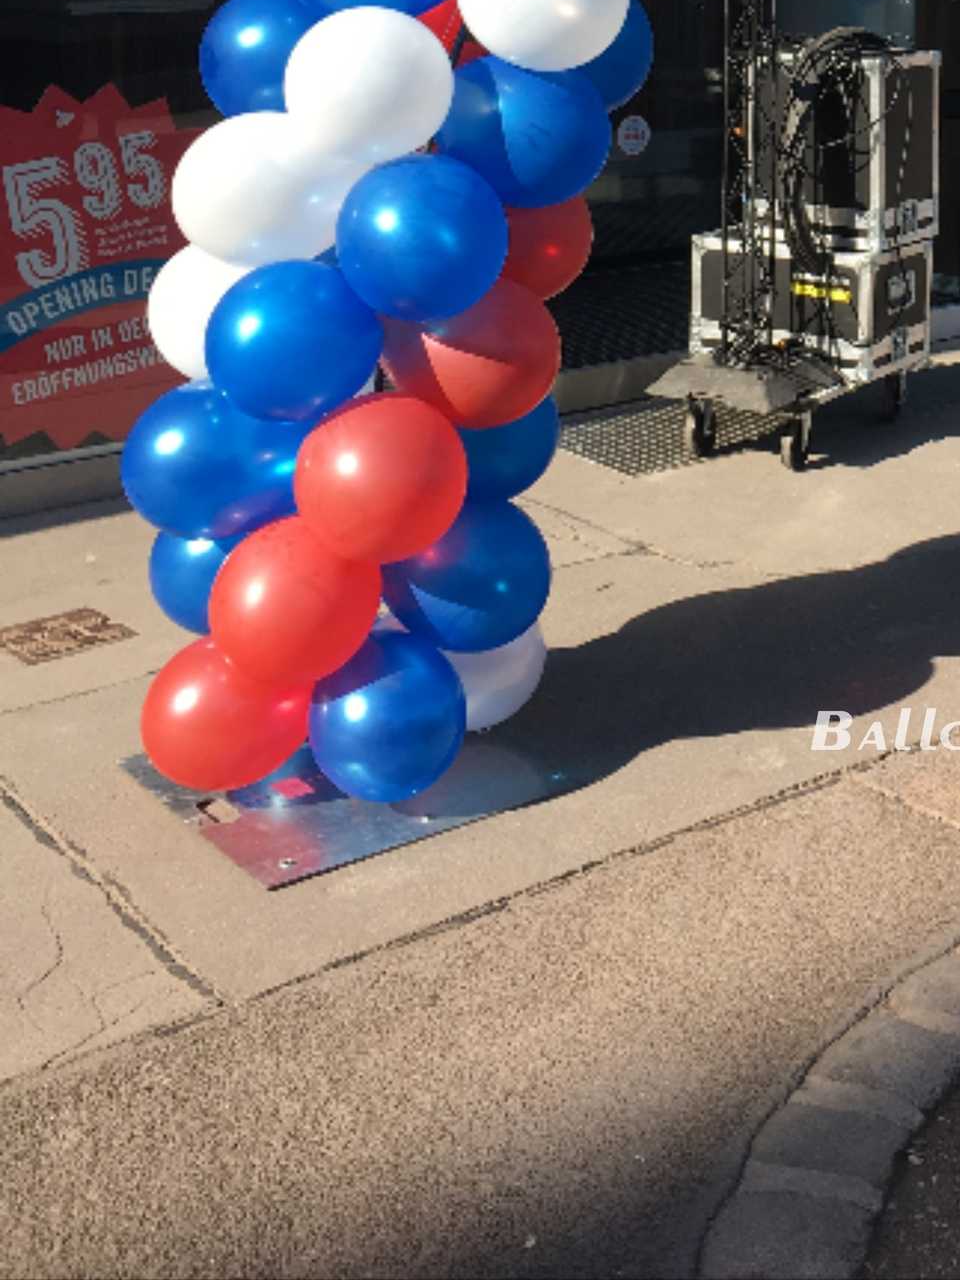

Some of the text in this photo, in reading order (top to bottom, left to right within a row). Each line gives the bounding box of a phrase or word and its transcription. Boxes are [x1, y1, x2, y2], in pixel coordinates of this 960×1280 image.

[6, 273, 114, 336] OPENING
[43, 335, 87, 364] NUR
[91, 326, 113, 351] IN
